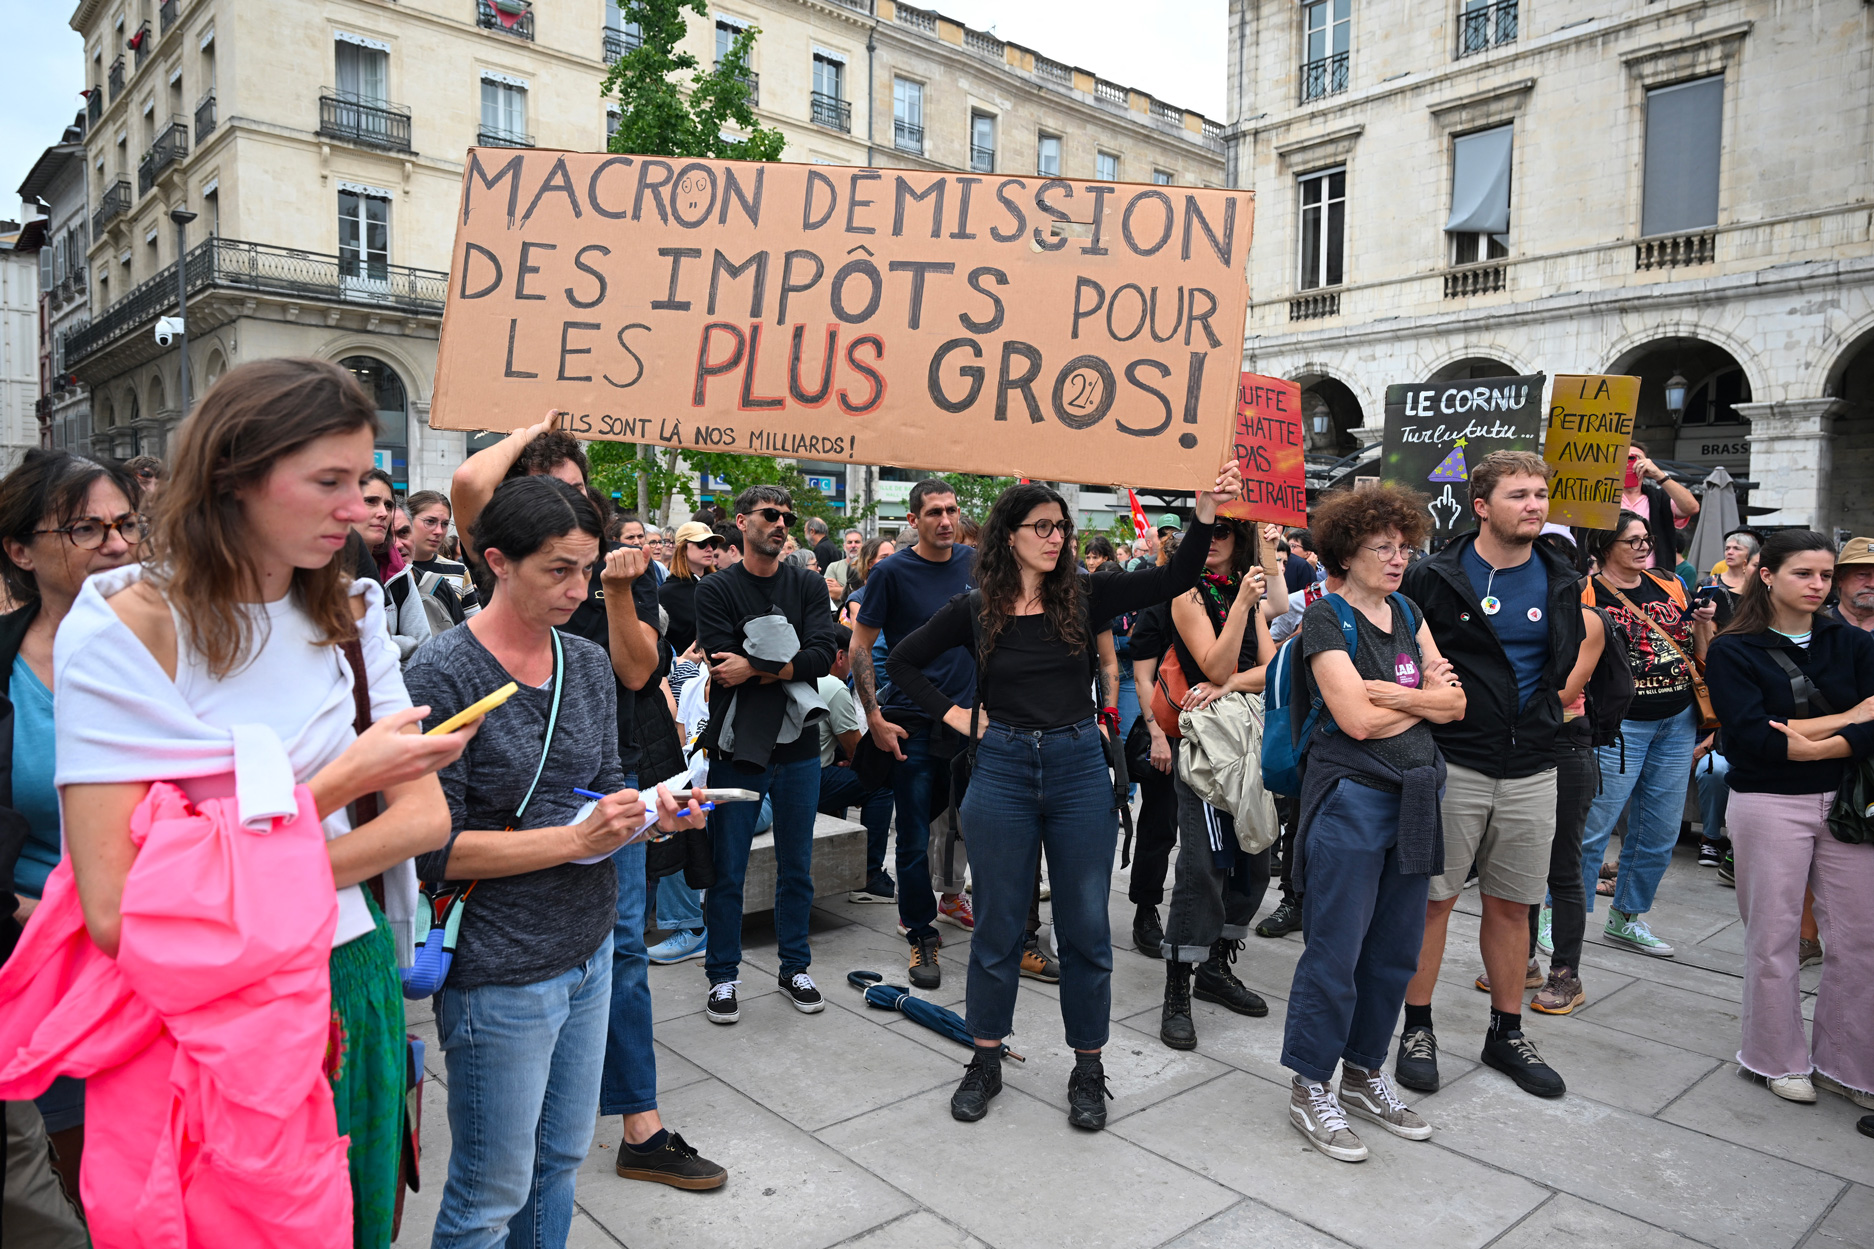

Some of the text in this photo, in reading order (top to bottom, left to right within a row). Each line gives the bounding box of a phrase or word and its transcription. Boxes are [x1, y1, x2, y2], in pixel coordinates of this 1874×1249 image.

[463, 153, 764, 230] MACRON
[460, 240, 1222, 349] DES IMPÔTS POUR
[504, 318, 1208, 449] LES PLUS GROS!
[1405, 385, 1529, 416] LE CORNU
[1579, 379, 1611, 400] LA
[557, 411, 856, 459] ILS SONT LÀ NOS MILLIARDS!
[1559, 441, 1625, 463] AVANT
[1235, 443, 1272, 472] PAS
